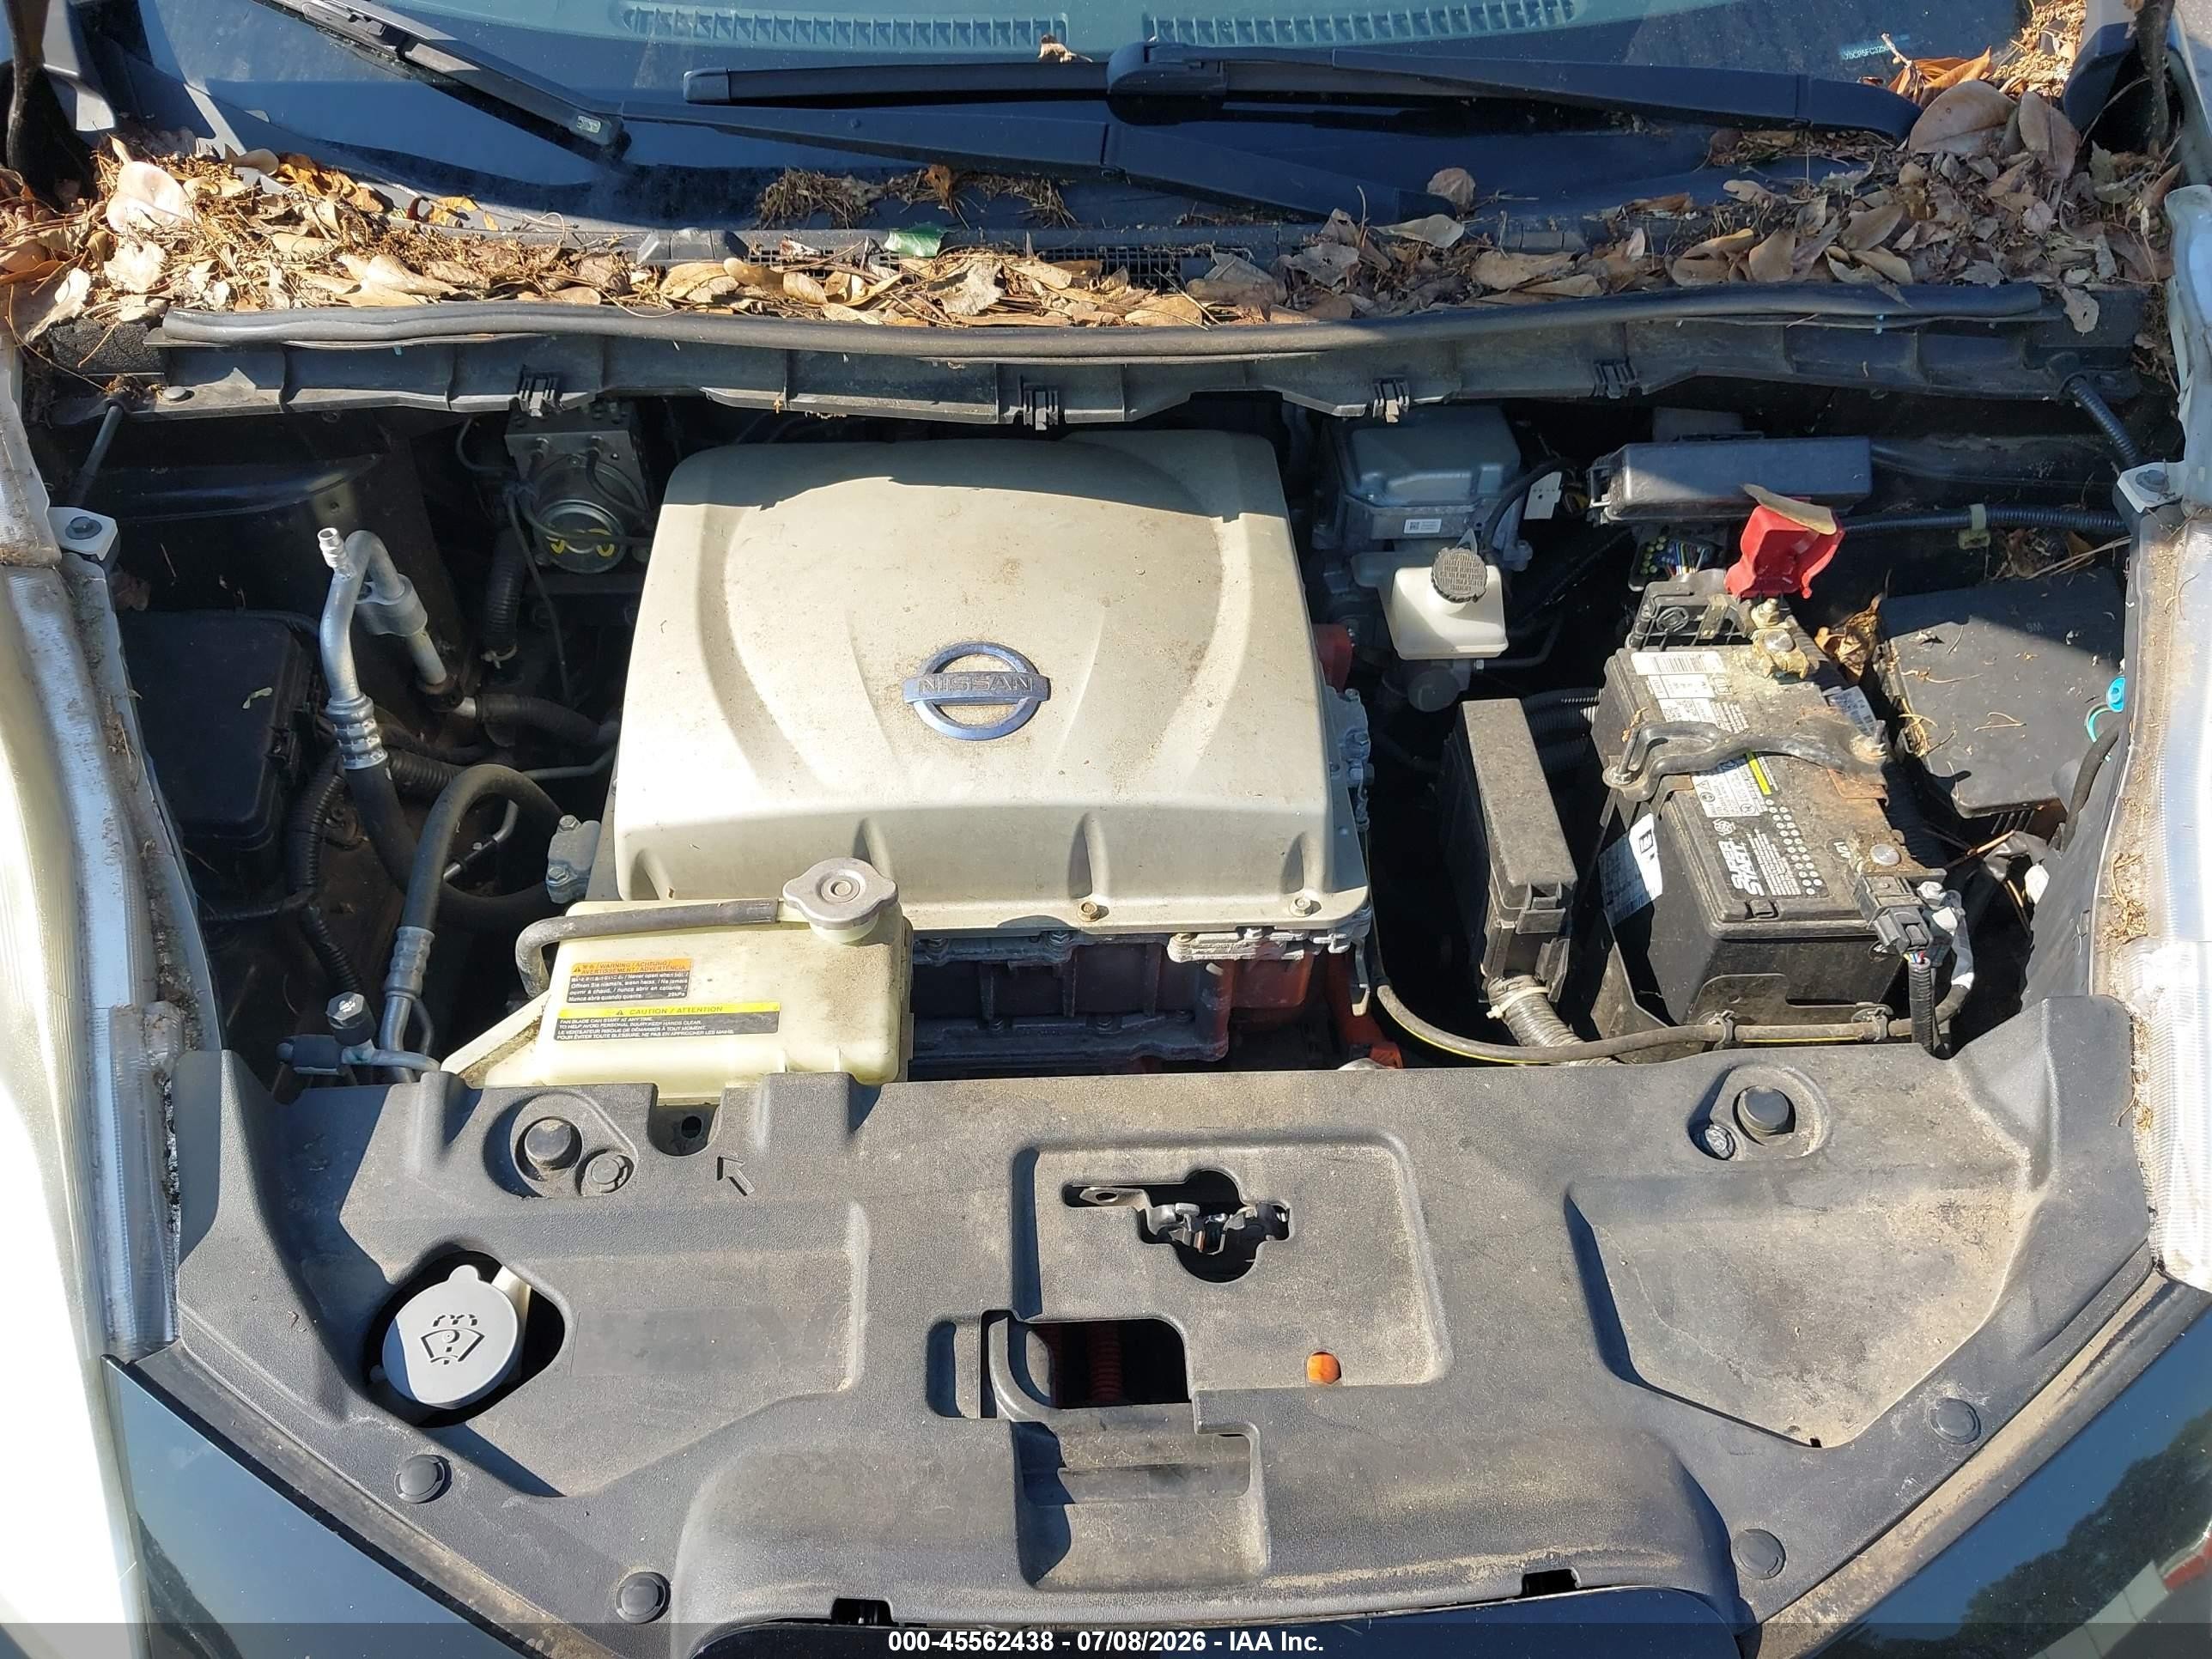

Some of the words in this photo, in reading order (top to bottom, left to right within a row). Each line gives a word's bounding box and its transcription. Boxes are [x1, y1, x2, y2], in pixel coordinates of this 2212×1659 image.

[919, 676, 1033, 696] NISSAN
[1718, 840, 1744, 890] SUPER
[1731, 841, 1765, 896] START
